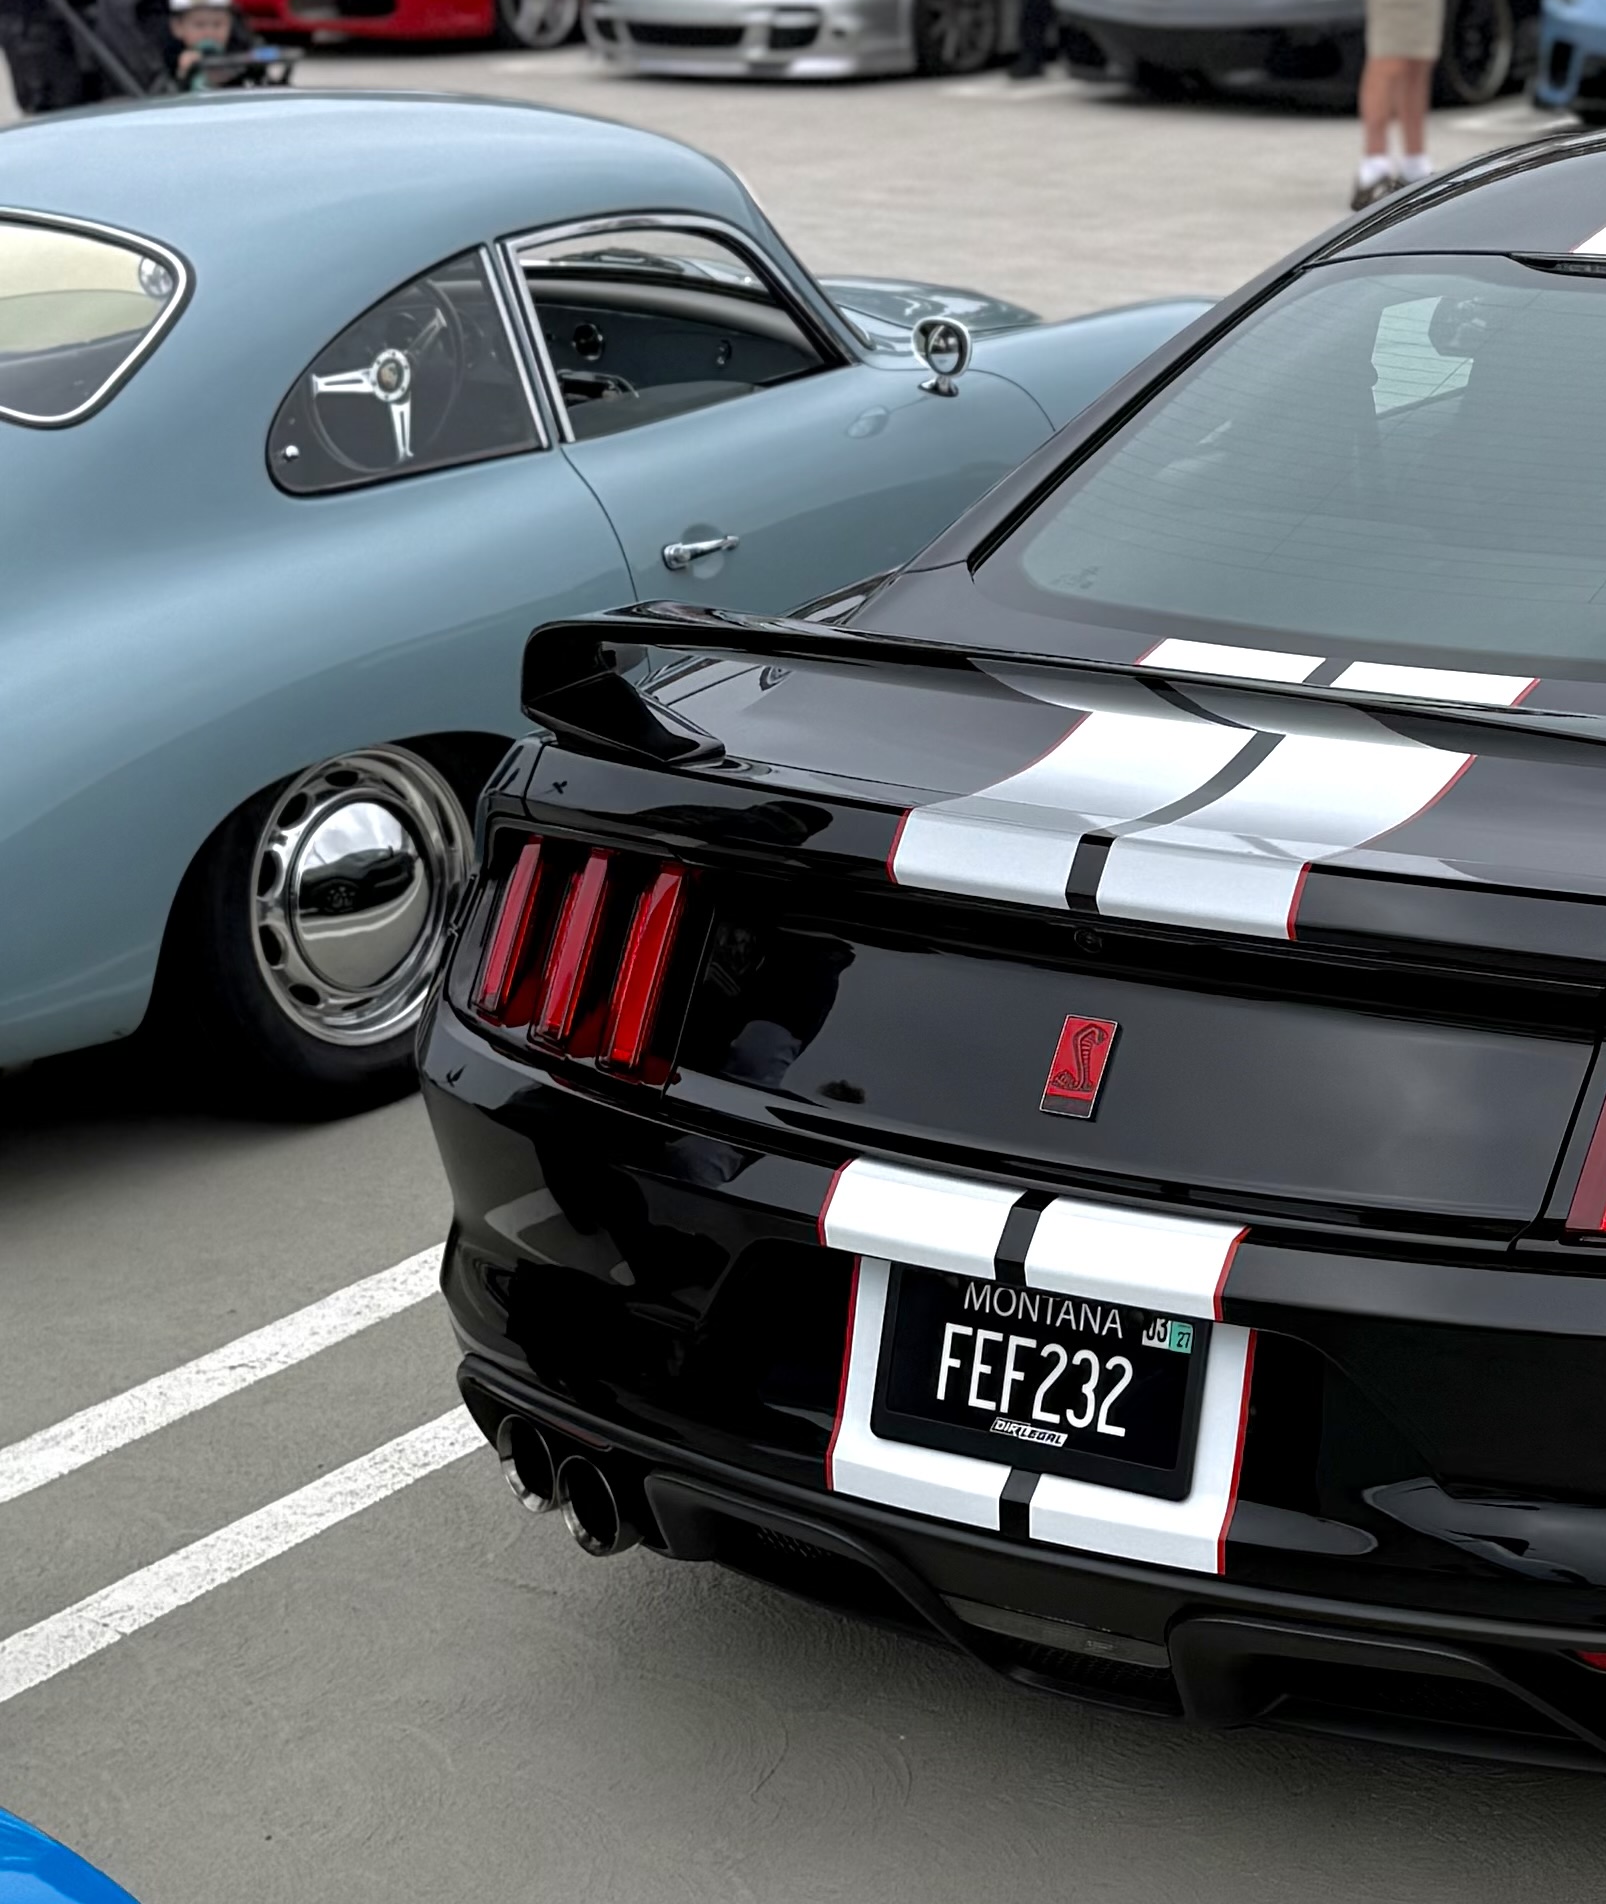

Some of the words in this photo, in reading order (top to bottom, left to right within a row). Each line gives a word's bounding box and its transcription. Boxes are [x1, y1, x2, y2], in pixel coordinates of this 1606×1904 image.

[964, 1281, 1123, 1339] MONTANA
[1176, 1331, 1191, 1349] 27
[936, 1322, 1133, 1437] FEF232
